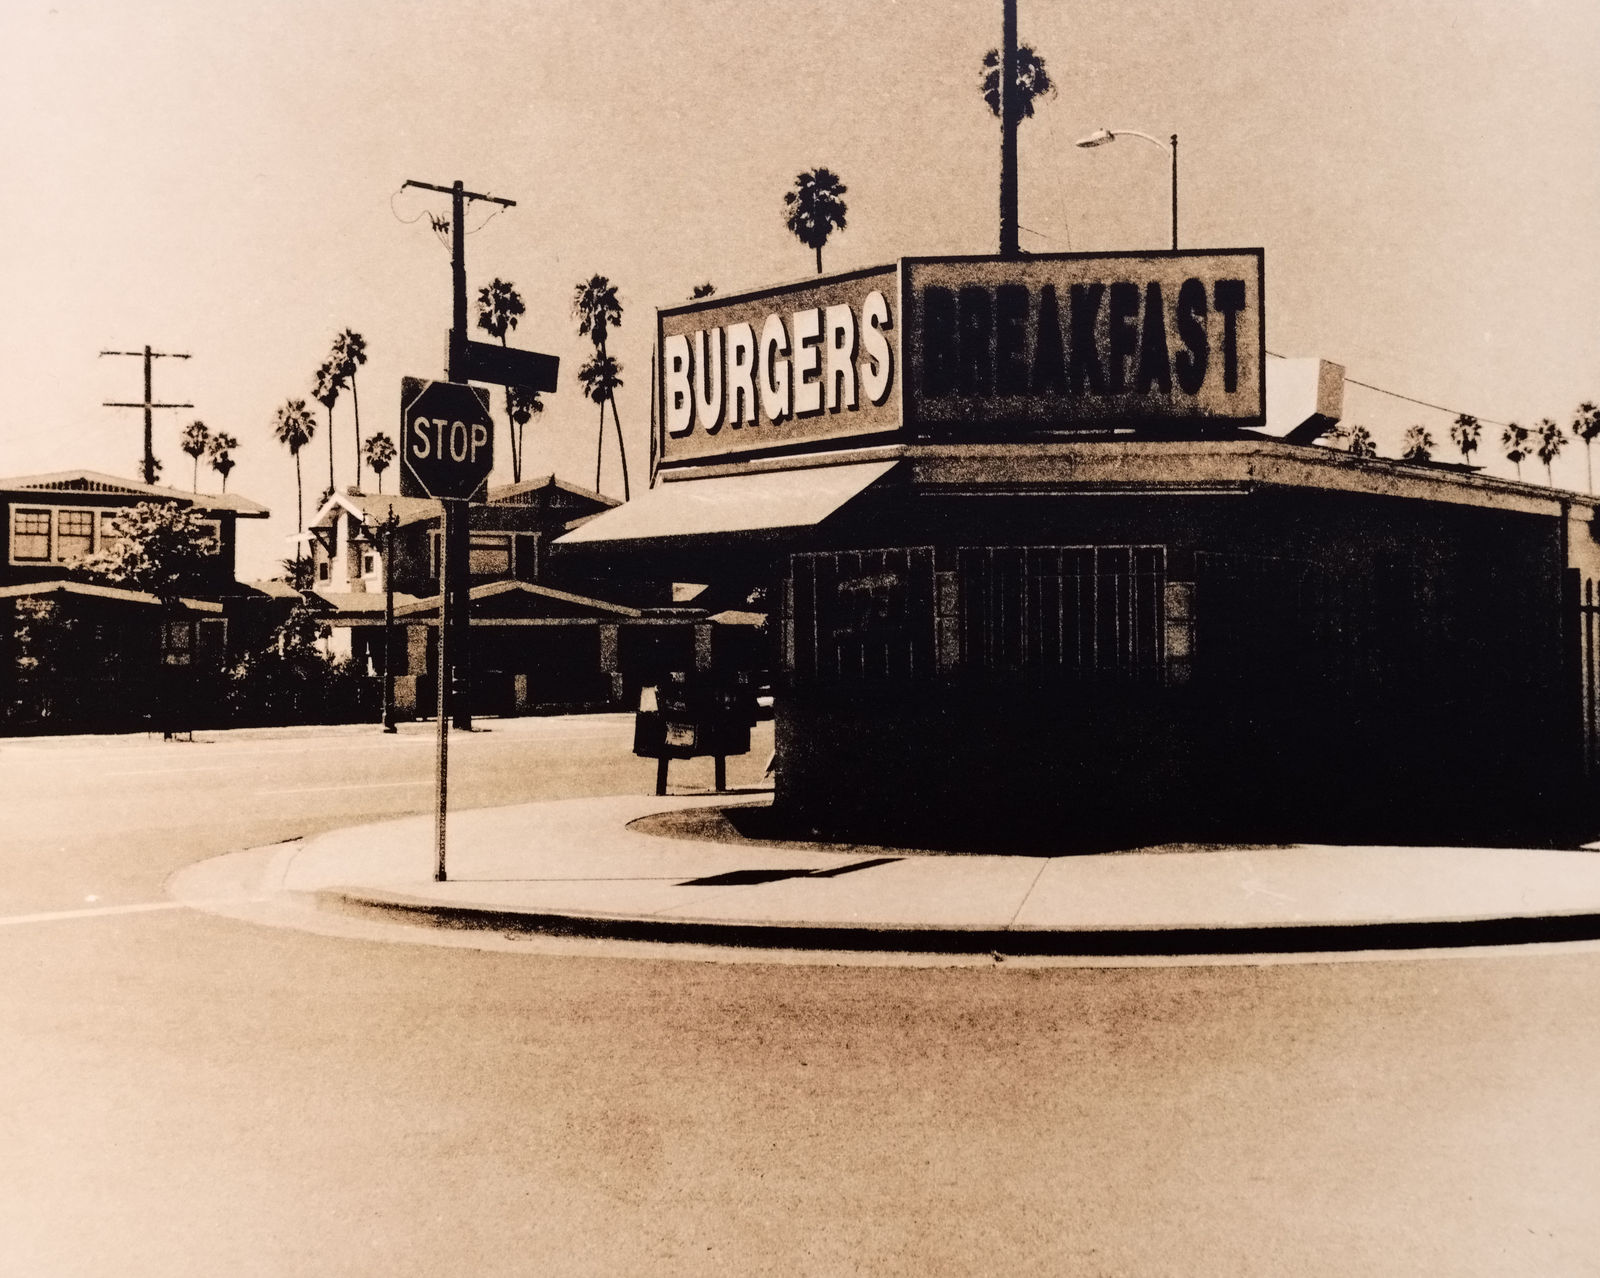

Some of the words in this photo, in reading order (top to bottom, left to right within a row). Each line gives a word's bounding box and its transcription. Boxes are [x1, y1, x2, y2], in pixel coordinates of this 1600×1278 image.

[665, 290, 893, 437] BURGERS
[922, 277, 1246, 396] BREAKFAST
[412, 416, 488, 463] STOP
